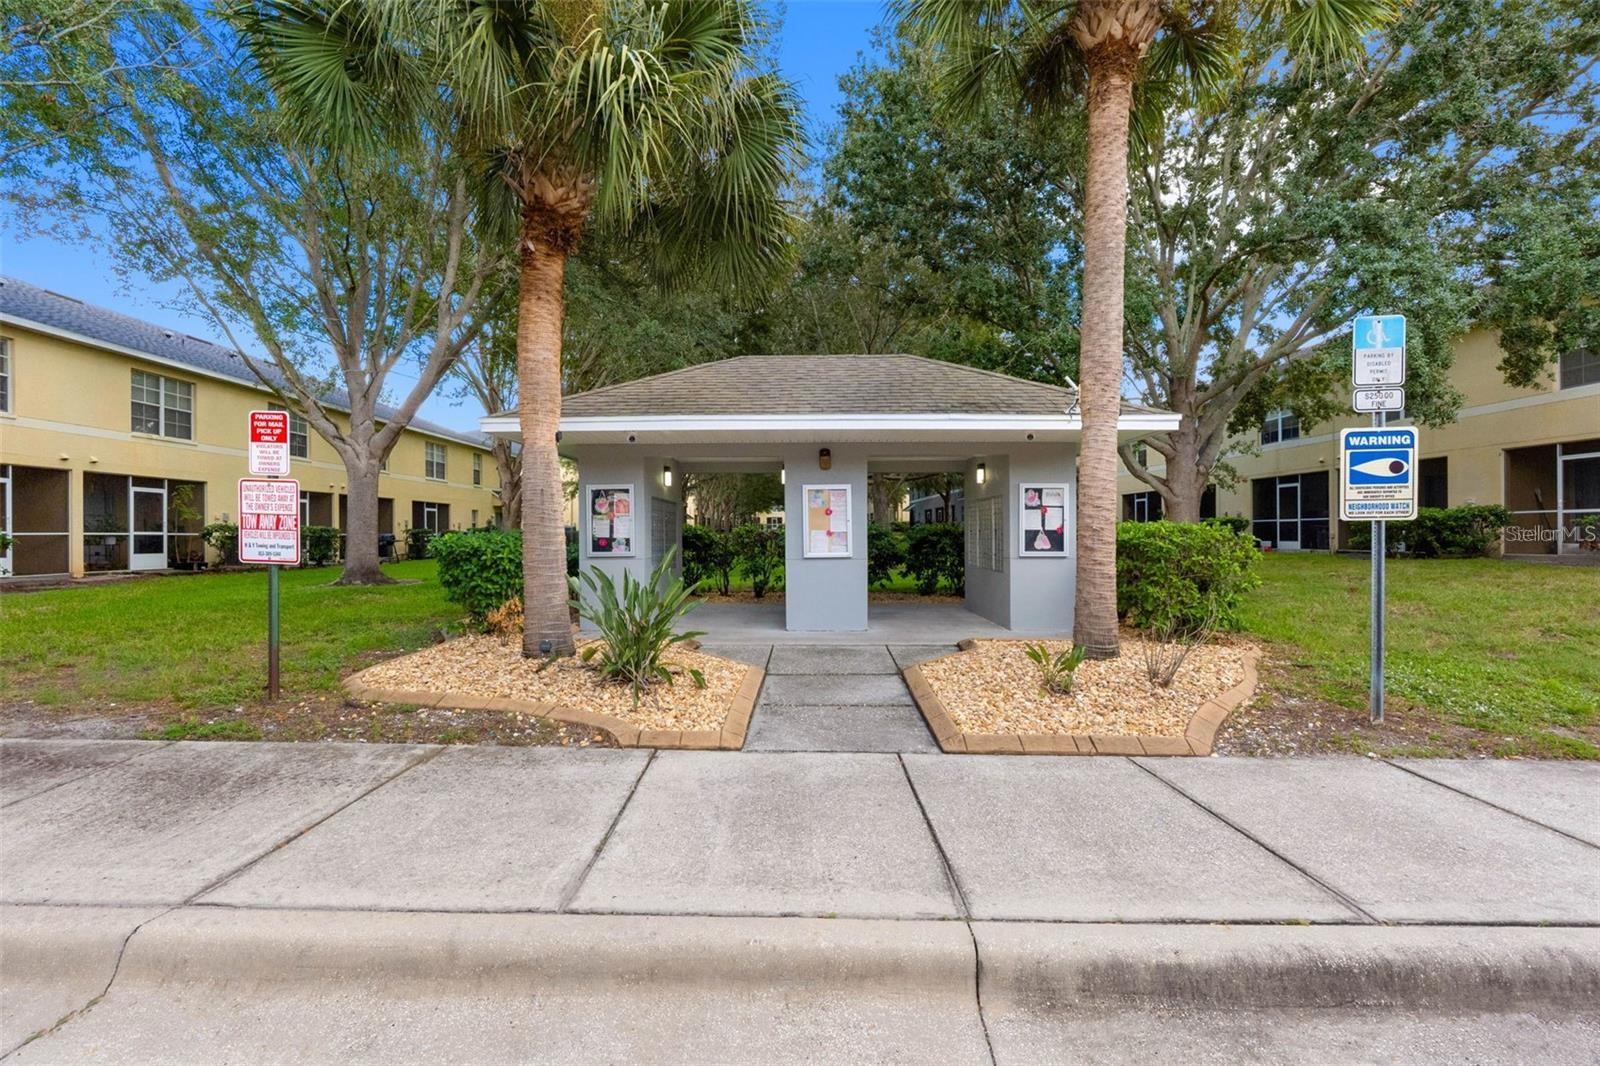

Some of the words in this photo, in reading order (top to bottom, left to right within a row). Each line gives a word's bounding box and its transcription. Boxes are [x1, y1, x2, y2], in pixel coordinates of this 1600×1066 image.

[1348, 434, 1411, 446] WARNING
[276, 485, 295, 493] VEHICLES
[262, 494, 276, 502] TOWED
[255, 503, 273, 511] OWNER'S
[275, 503, 292, 511] EXPENSE
[242, 514, 257, 529] TOW
[259, 514, 276, 529] AWAY
[278, 515, 297, 530] ZONE
